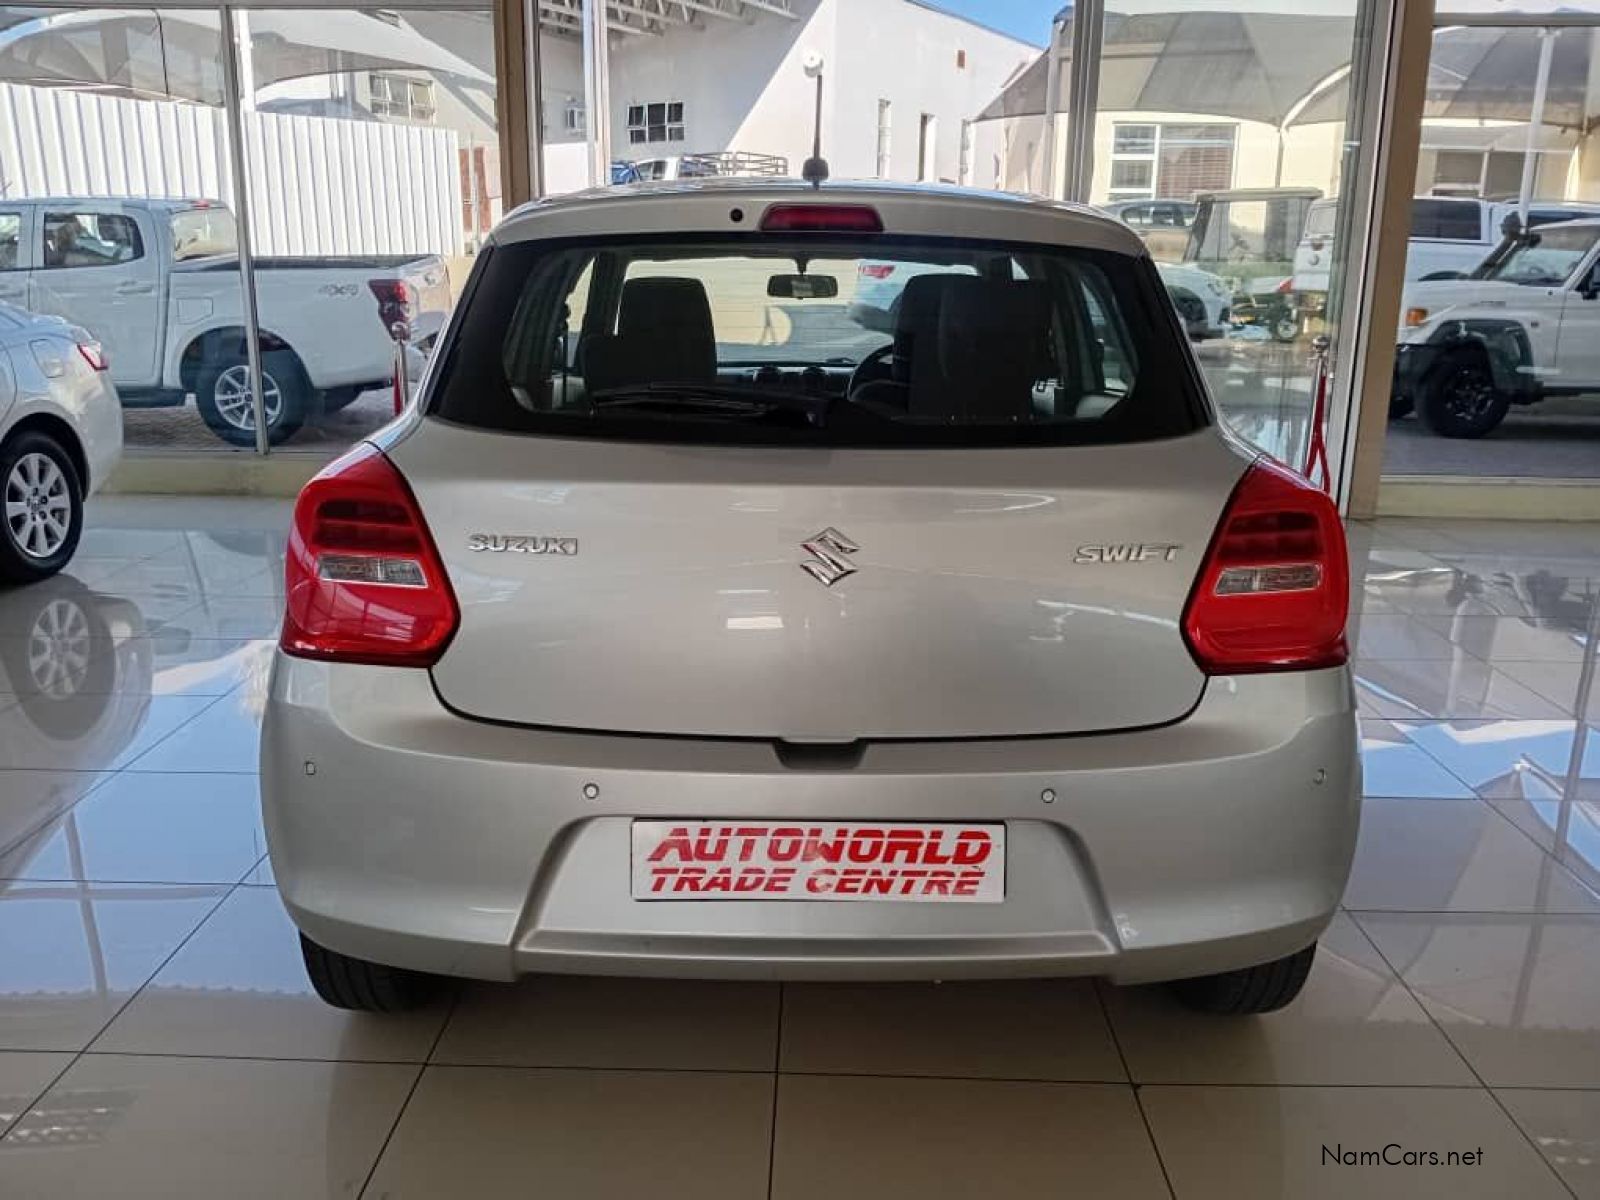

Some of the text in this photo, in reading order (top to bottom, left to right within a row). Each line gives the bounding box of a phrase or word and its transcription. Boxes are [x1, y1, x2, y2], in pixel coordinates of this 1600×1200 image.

[468, 535, 578, 555] SUZUKI
[1073, 544, 1183, 564] SWIFT
[647, 827, 992, 865] AUTOWORLD
[650, 867, 986, 895] TRADE CENTRE
